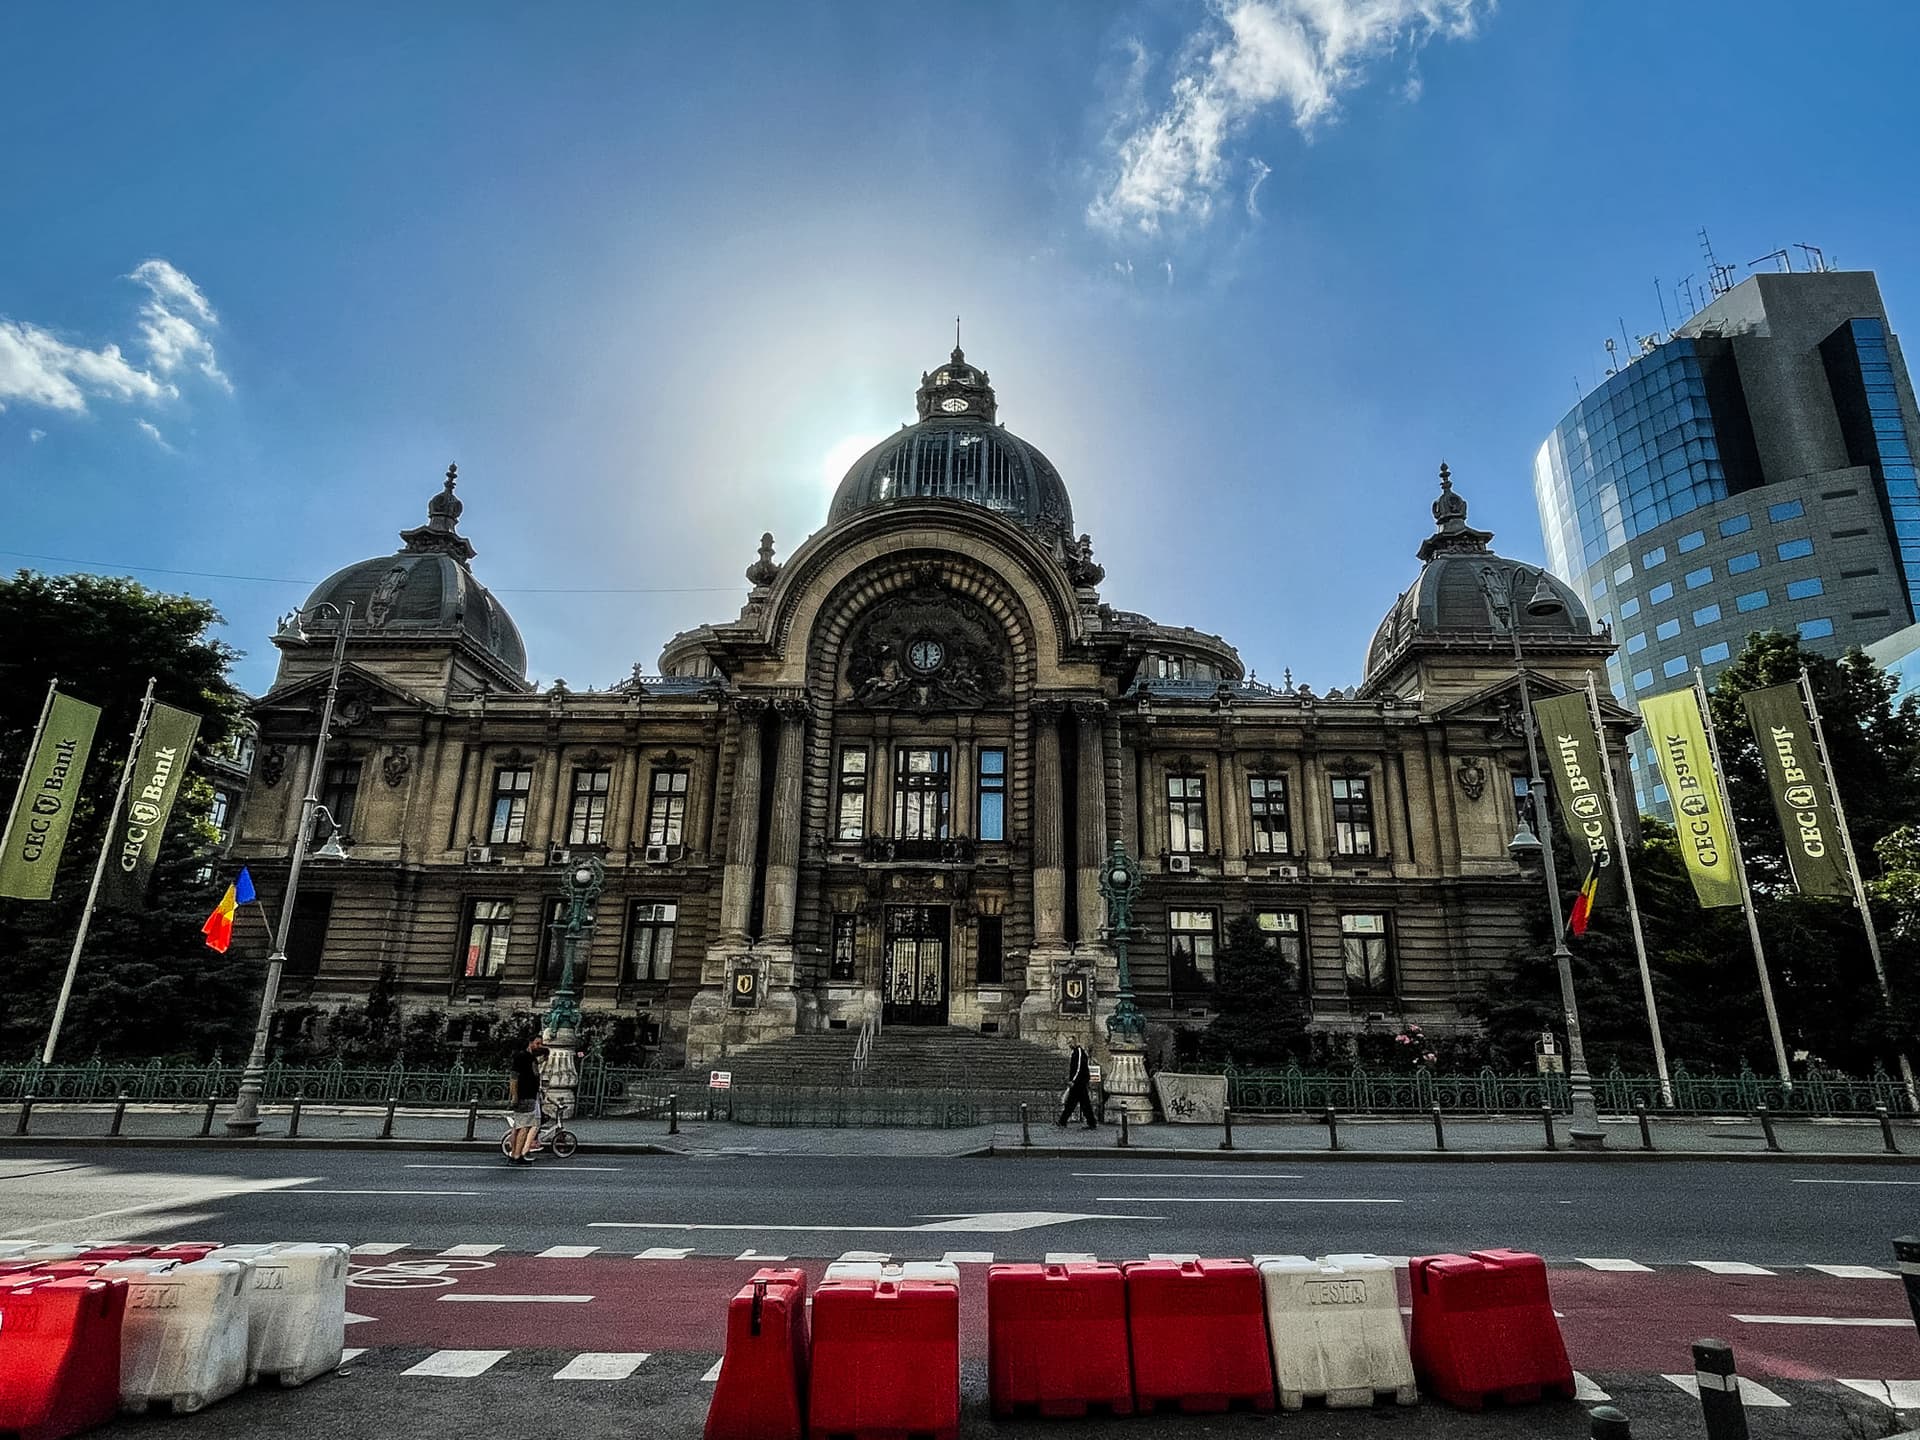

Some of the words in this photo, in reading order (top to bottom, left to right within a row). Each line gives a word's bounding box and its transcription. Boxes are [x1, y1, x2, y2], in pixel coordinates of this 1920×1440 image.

[22, 818, 50, 862] CEC
[43, 738, 78, 792] Bank
[121, 827, 148, 872] CEC
[141, 746, 177, 801] Bank
